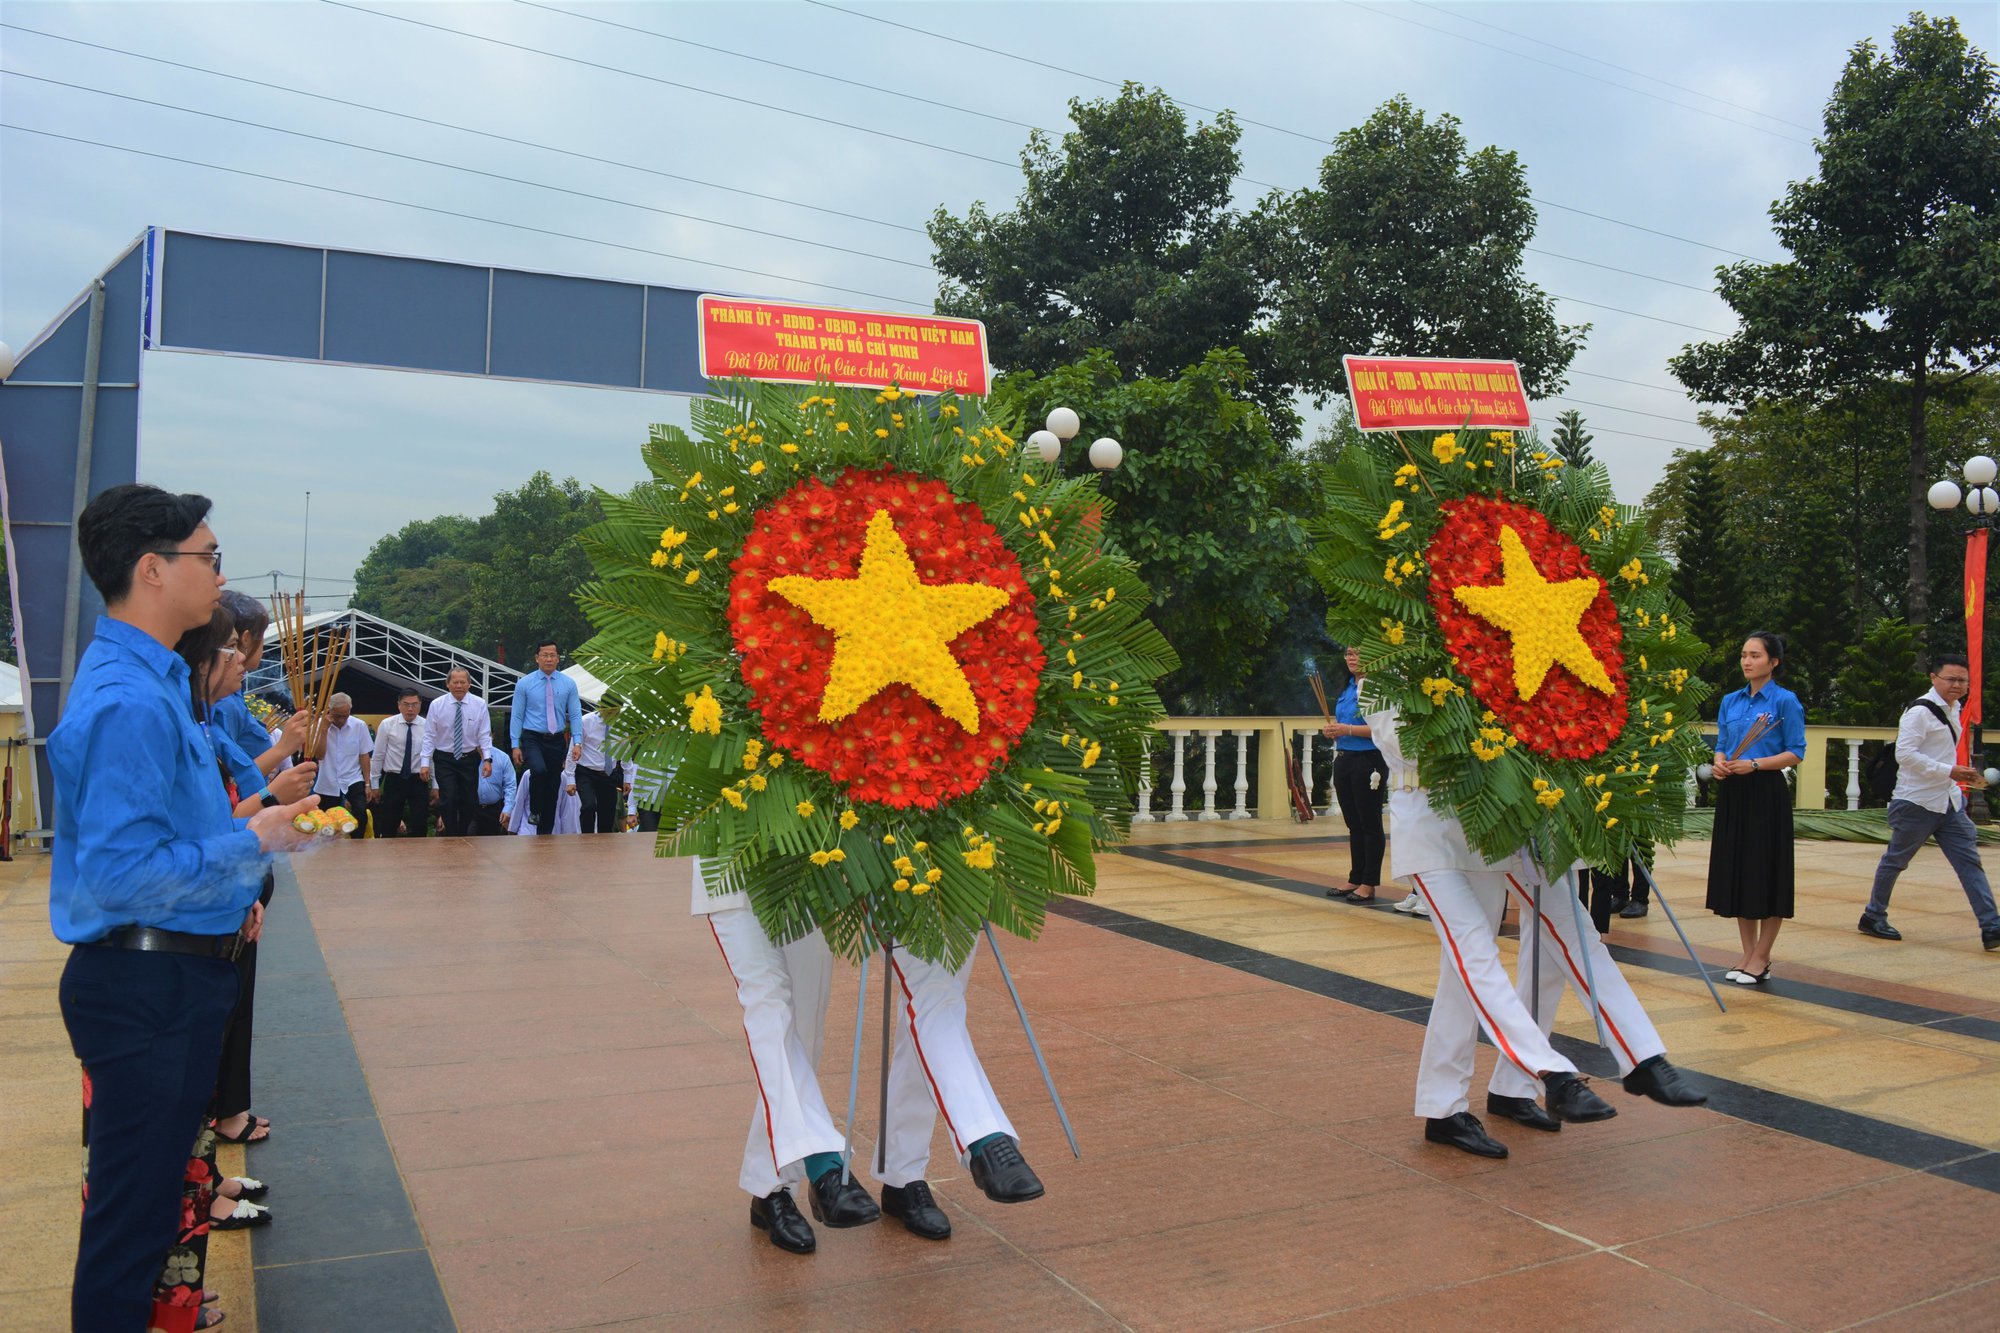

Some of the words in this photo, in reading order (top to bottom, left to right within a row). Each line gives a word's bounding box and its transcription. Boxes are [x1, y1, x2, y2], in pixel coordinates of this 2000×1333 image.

[710, 305, 753, 324] THÀNH
[756, 307, 772, 326] ỦY
[783, 313, 815, 331] HĐND
[825, 317, 857, 335] UBND
[866, 322, 918, 342] UB.MTTQ
[920, 325, 947, 346] VIỆT
[951, 329, 975, 345] NAM
[775, 331, 817, 349] THÀNH
[820, 334, 844, 352] PHỐ
[847, 336, 864, 354] HỒ
[866, 340, 887, 356] CHÍ
[889, 343, 919, 359] MINH
[724, 350, 751, 369] Đời
[753, 351, 779, 370] Đời
[782, 352, 812, 372] Nhớ
[814, 354, 831, 374] Ơn
[834, 357, 857, 376] Các
[859, 360, 889, 379] Anh
[891, 362, 927, 387] Hùng
[929, 366, 953, 389] Liệt
[1506, 374, 1518, 393] 12
